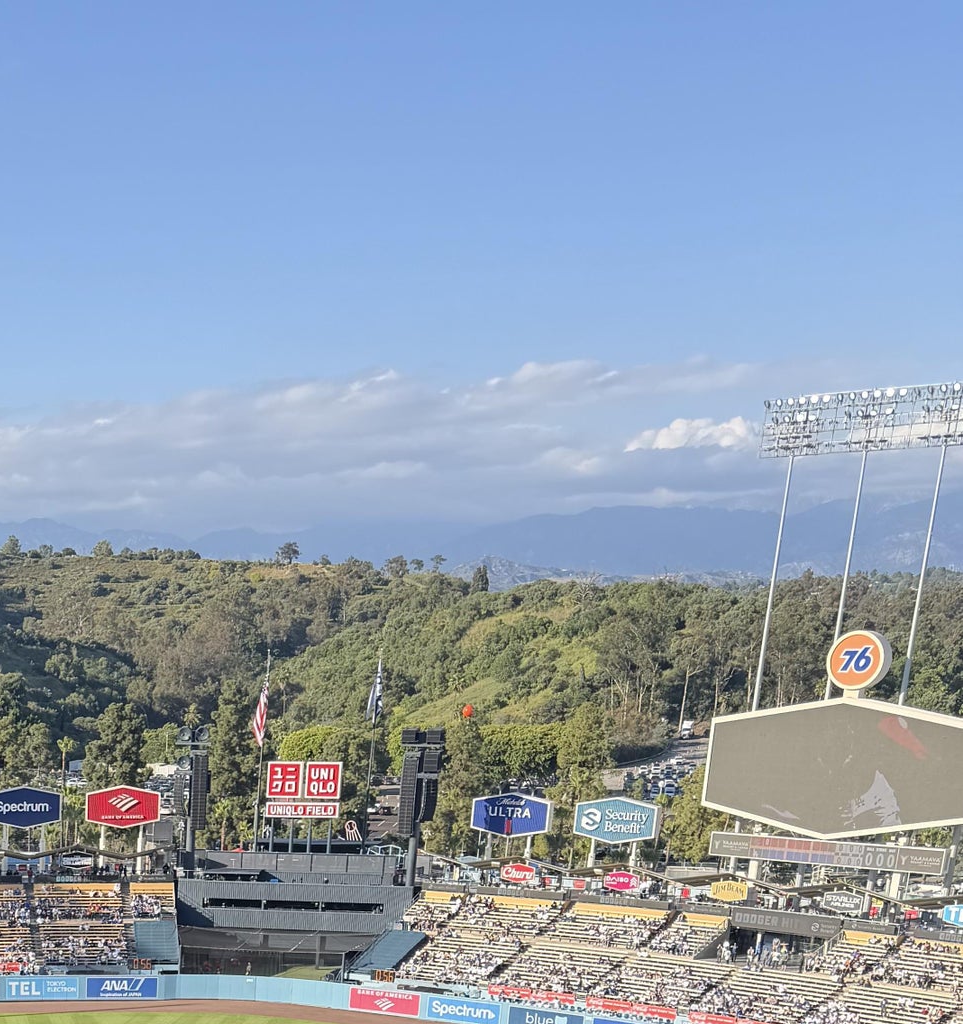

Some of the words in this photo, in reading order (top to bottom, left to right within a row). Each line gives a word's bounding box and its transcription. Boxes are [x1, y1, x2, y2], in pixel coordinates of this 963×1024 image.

[838, 645, 874, 673] 76
[272, 768, 296, 778] ユニ
[311, 768, 334, 780] UNI
[272, 781, 296, 792] クロ
[310, 782, 335, 794] QLO
[270, 806, 304, 816] UNIQLO
[306, 806, 334, 816] FIELD
[489, 806, 531, 818] ULTRA
[605, 809, 649, 823] Security
[604, 821, 642, 834] Benefit
[502, 867, 534, 880] Churu
[737, 912, 778, 927] DODGER
[9, 982, 40, 995] TEL
[101, 980, 128, 990] ANA
[385, 992, 412, 1000] AMERICA
[432, 1000, 491, 1020] Spectrum
